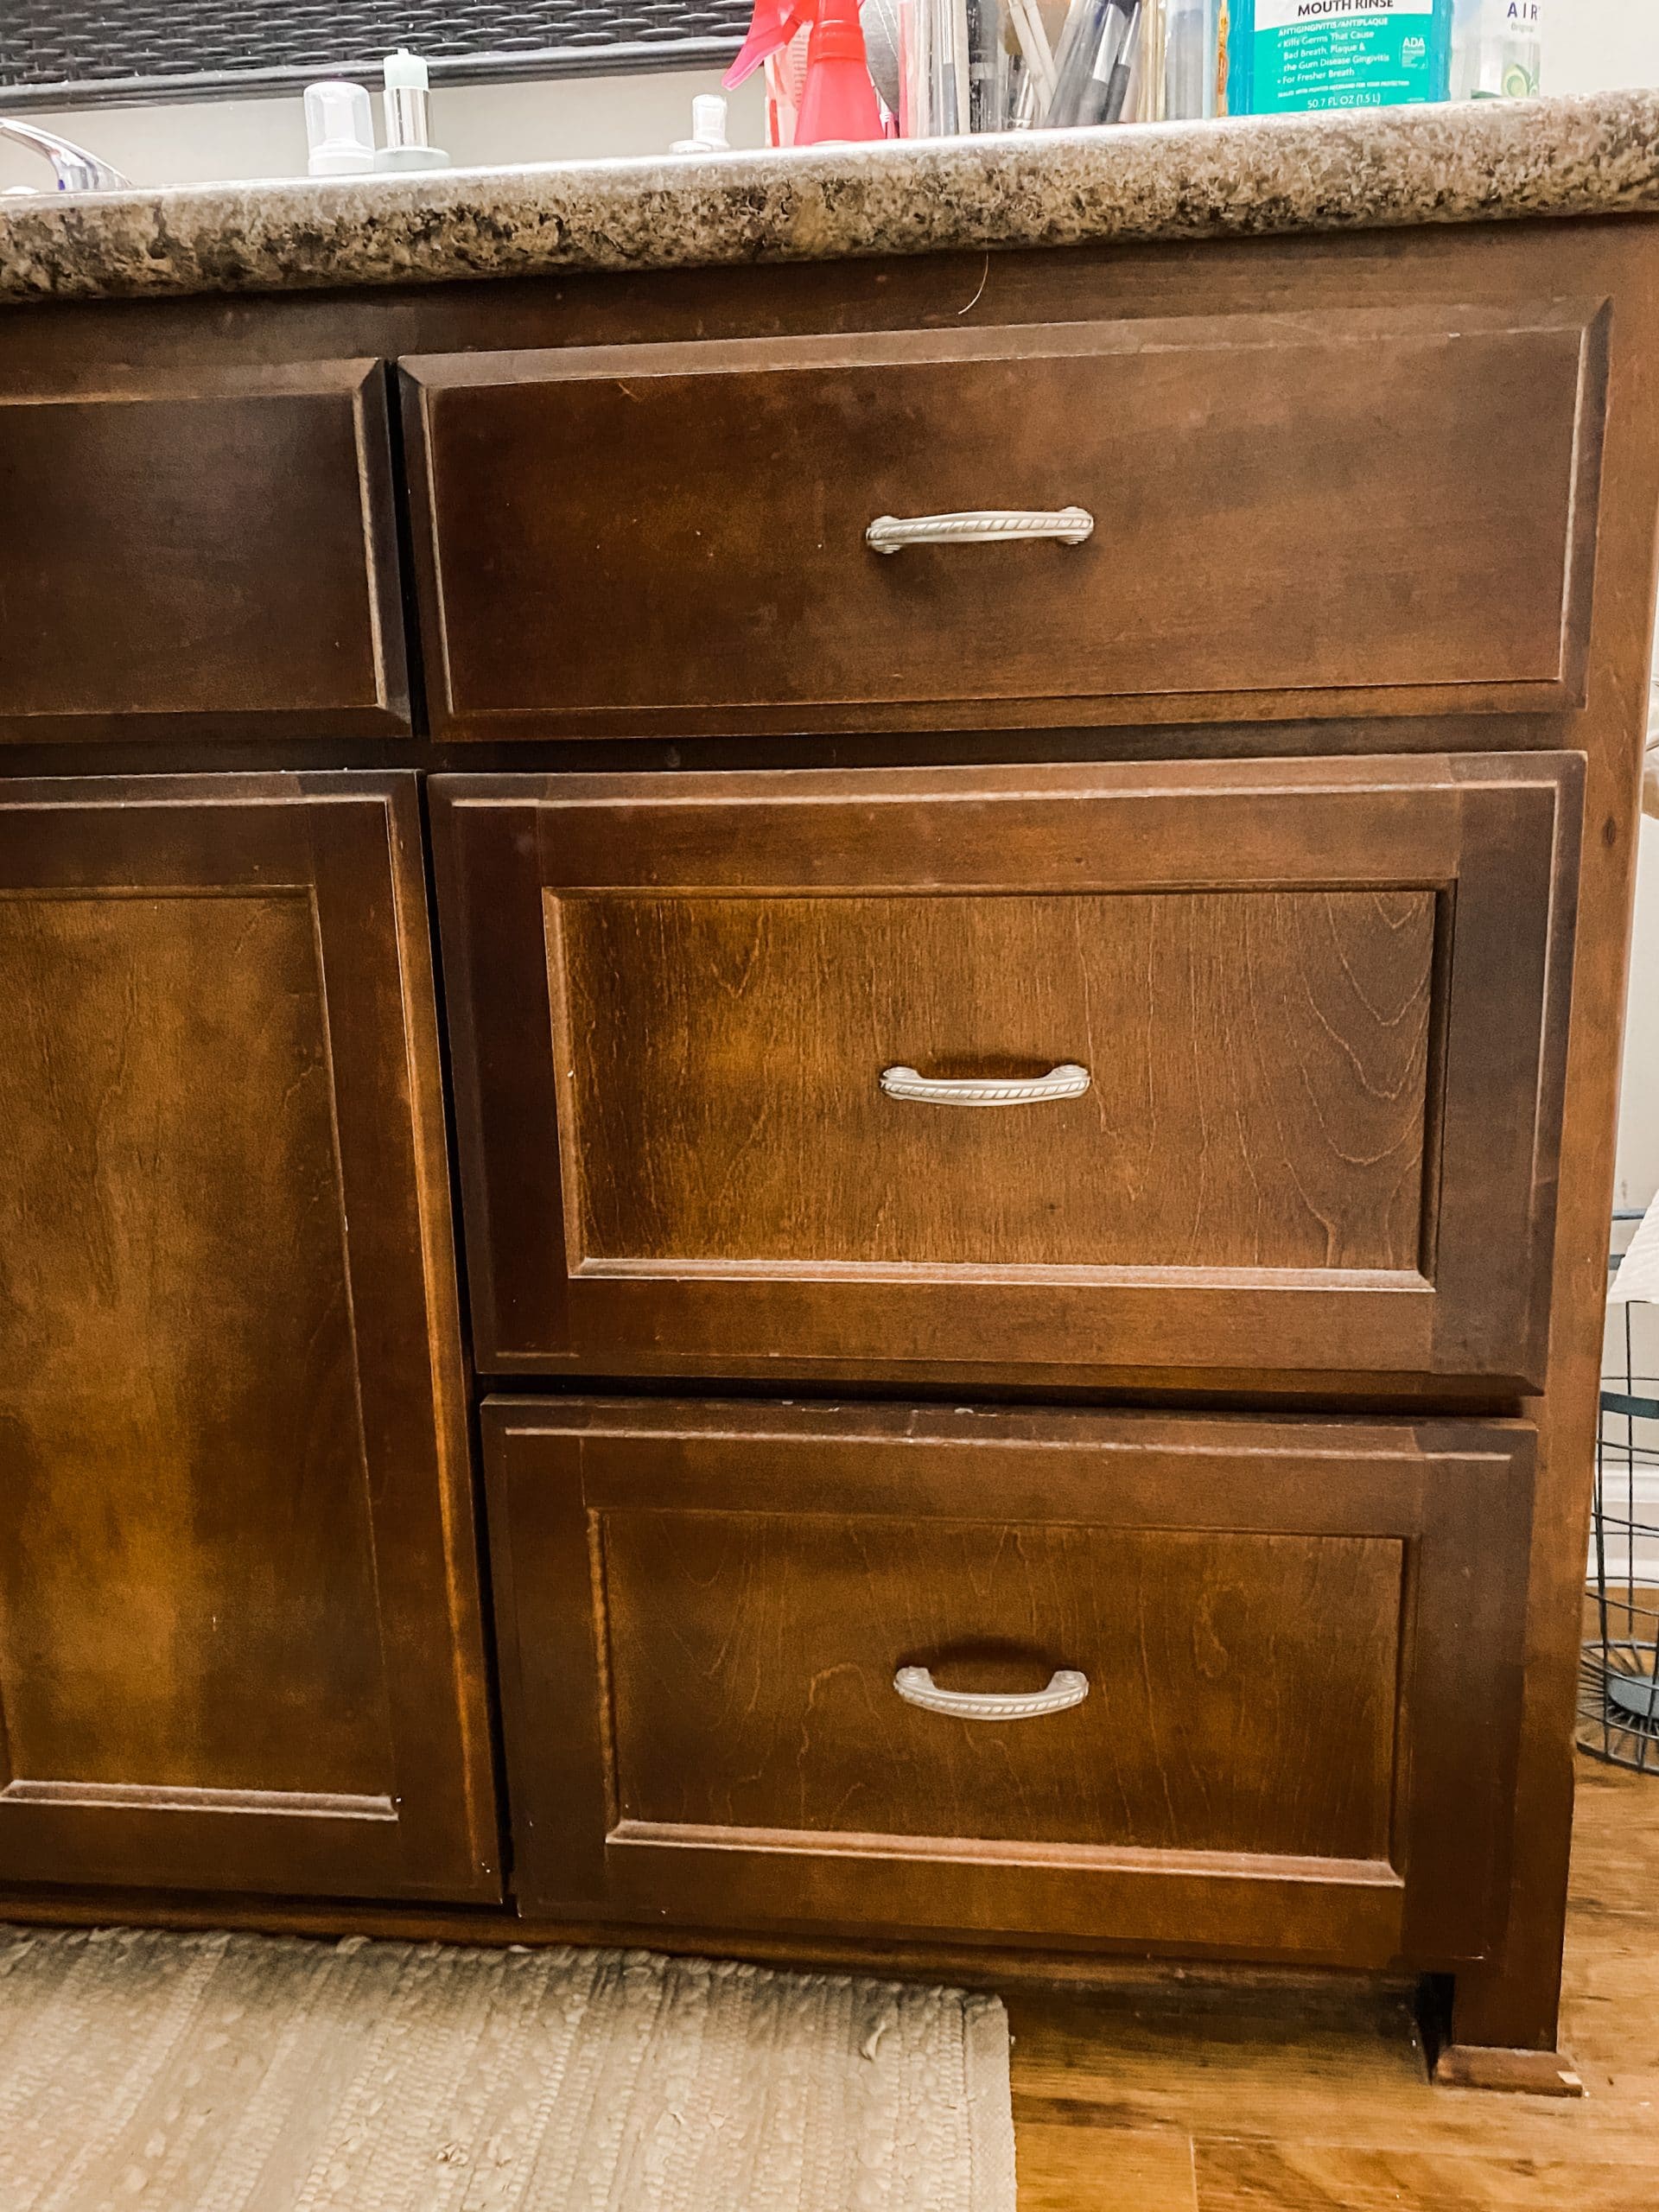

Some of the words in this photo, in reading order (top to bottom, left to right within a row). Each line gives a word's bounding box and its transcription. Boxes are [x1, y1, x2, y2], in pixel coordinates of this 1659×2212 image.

[1298, 0, 1351, 16] MOUTH
[1355, 0, 1394, 10] RINSE
[1507, 2, 1537, 21] AIR
[1283, 38, 1300, 48] Kills
[1301, 35, 1328, 45] Germs
[1330, 32, 1348, 41] That
[1350, 30, 1375, 40] Cause
[1402, 37, 1426, 48] ADA
[1284, 49, 1299, 60] Bad
[1330, 43, 1358, 55] Plaque
[1284, 63, 1297, 73] the
[1298, 60, 1319, 70] Gum
[1319, 57, 1351, 67] Disease
[1352, 54, 1390, 66] Gingivitis
[1282, 75, 1295, 85] For
[1297, 71, 1326, 82] Fresher
[1328, 67, 1355, 78] Breath
[1307, 97, 1327, 108] 50.7
[1328, 97, 1338, 105] FL
[1339, 95, 1355, 105] OZ
[1372, 92, 1382, 104] L)
